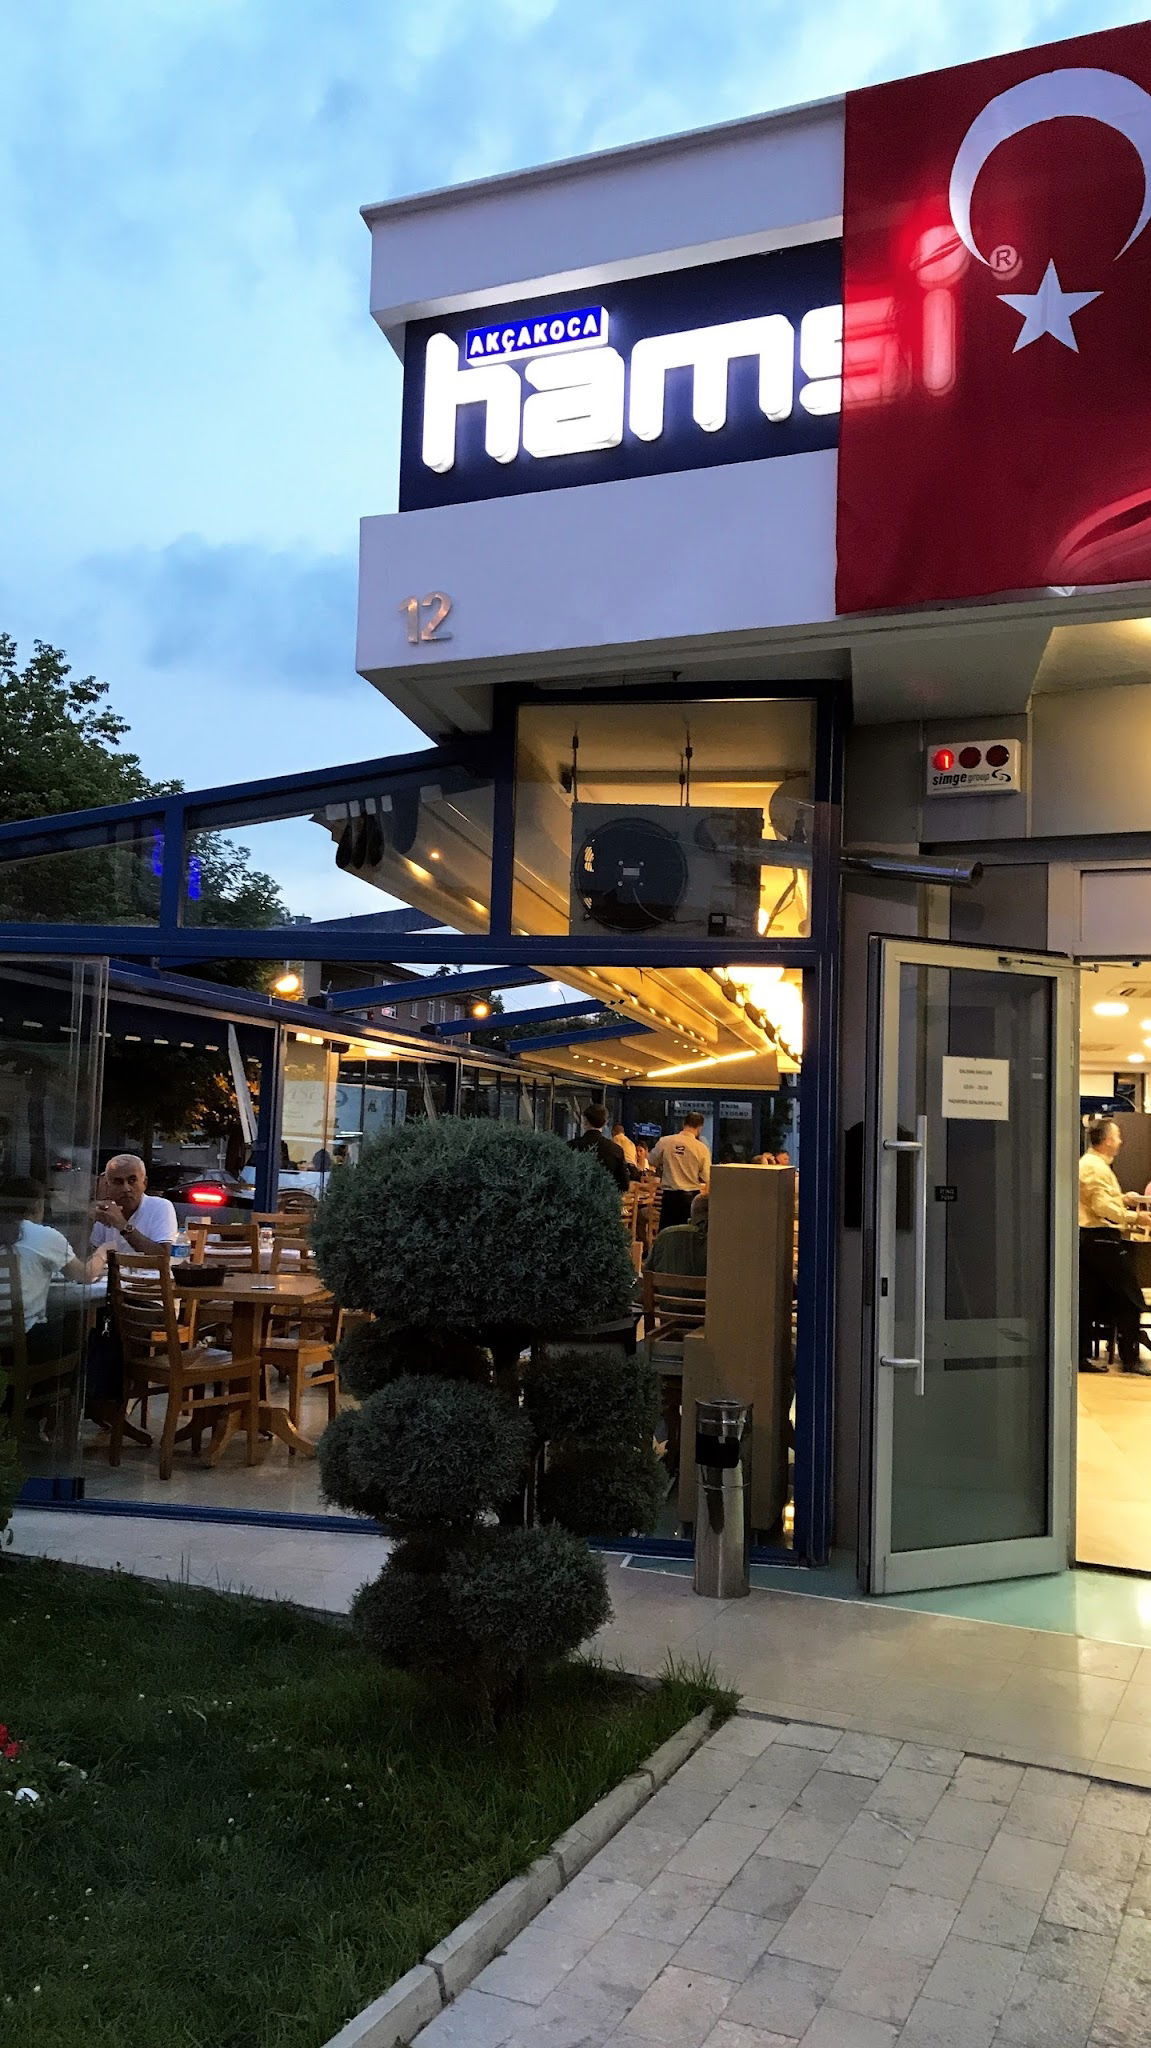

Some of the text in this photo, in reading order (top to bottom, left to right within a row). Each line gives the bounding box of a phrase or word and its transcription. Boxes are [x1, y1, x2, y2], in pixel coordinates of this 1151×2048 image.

[469, 313, 599, 353] AKÇAKOCA
[397, 591, 453, 644] 12
[932, 773, 990, 786] simge group
